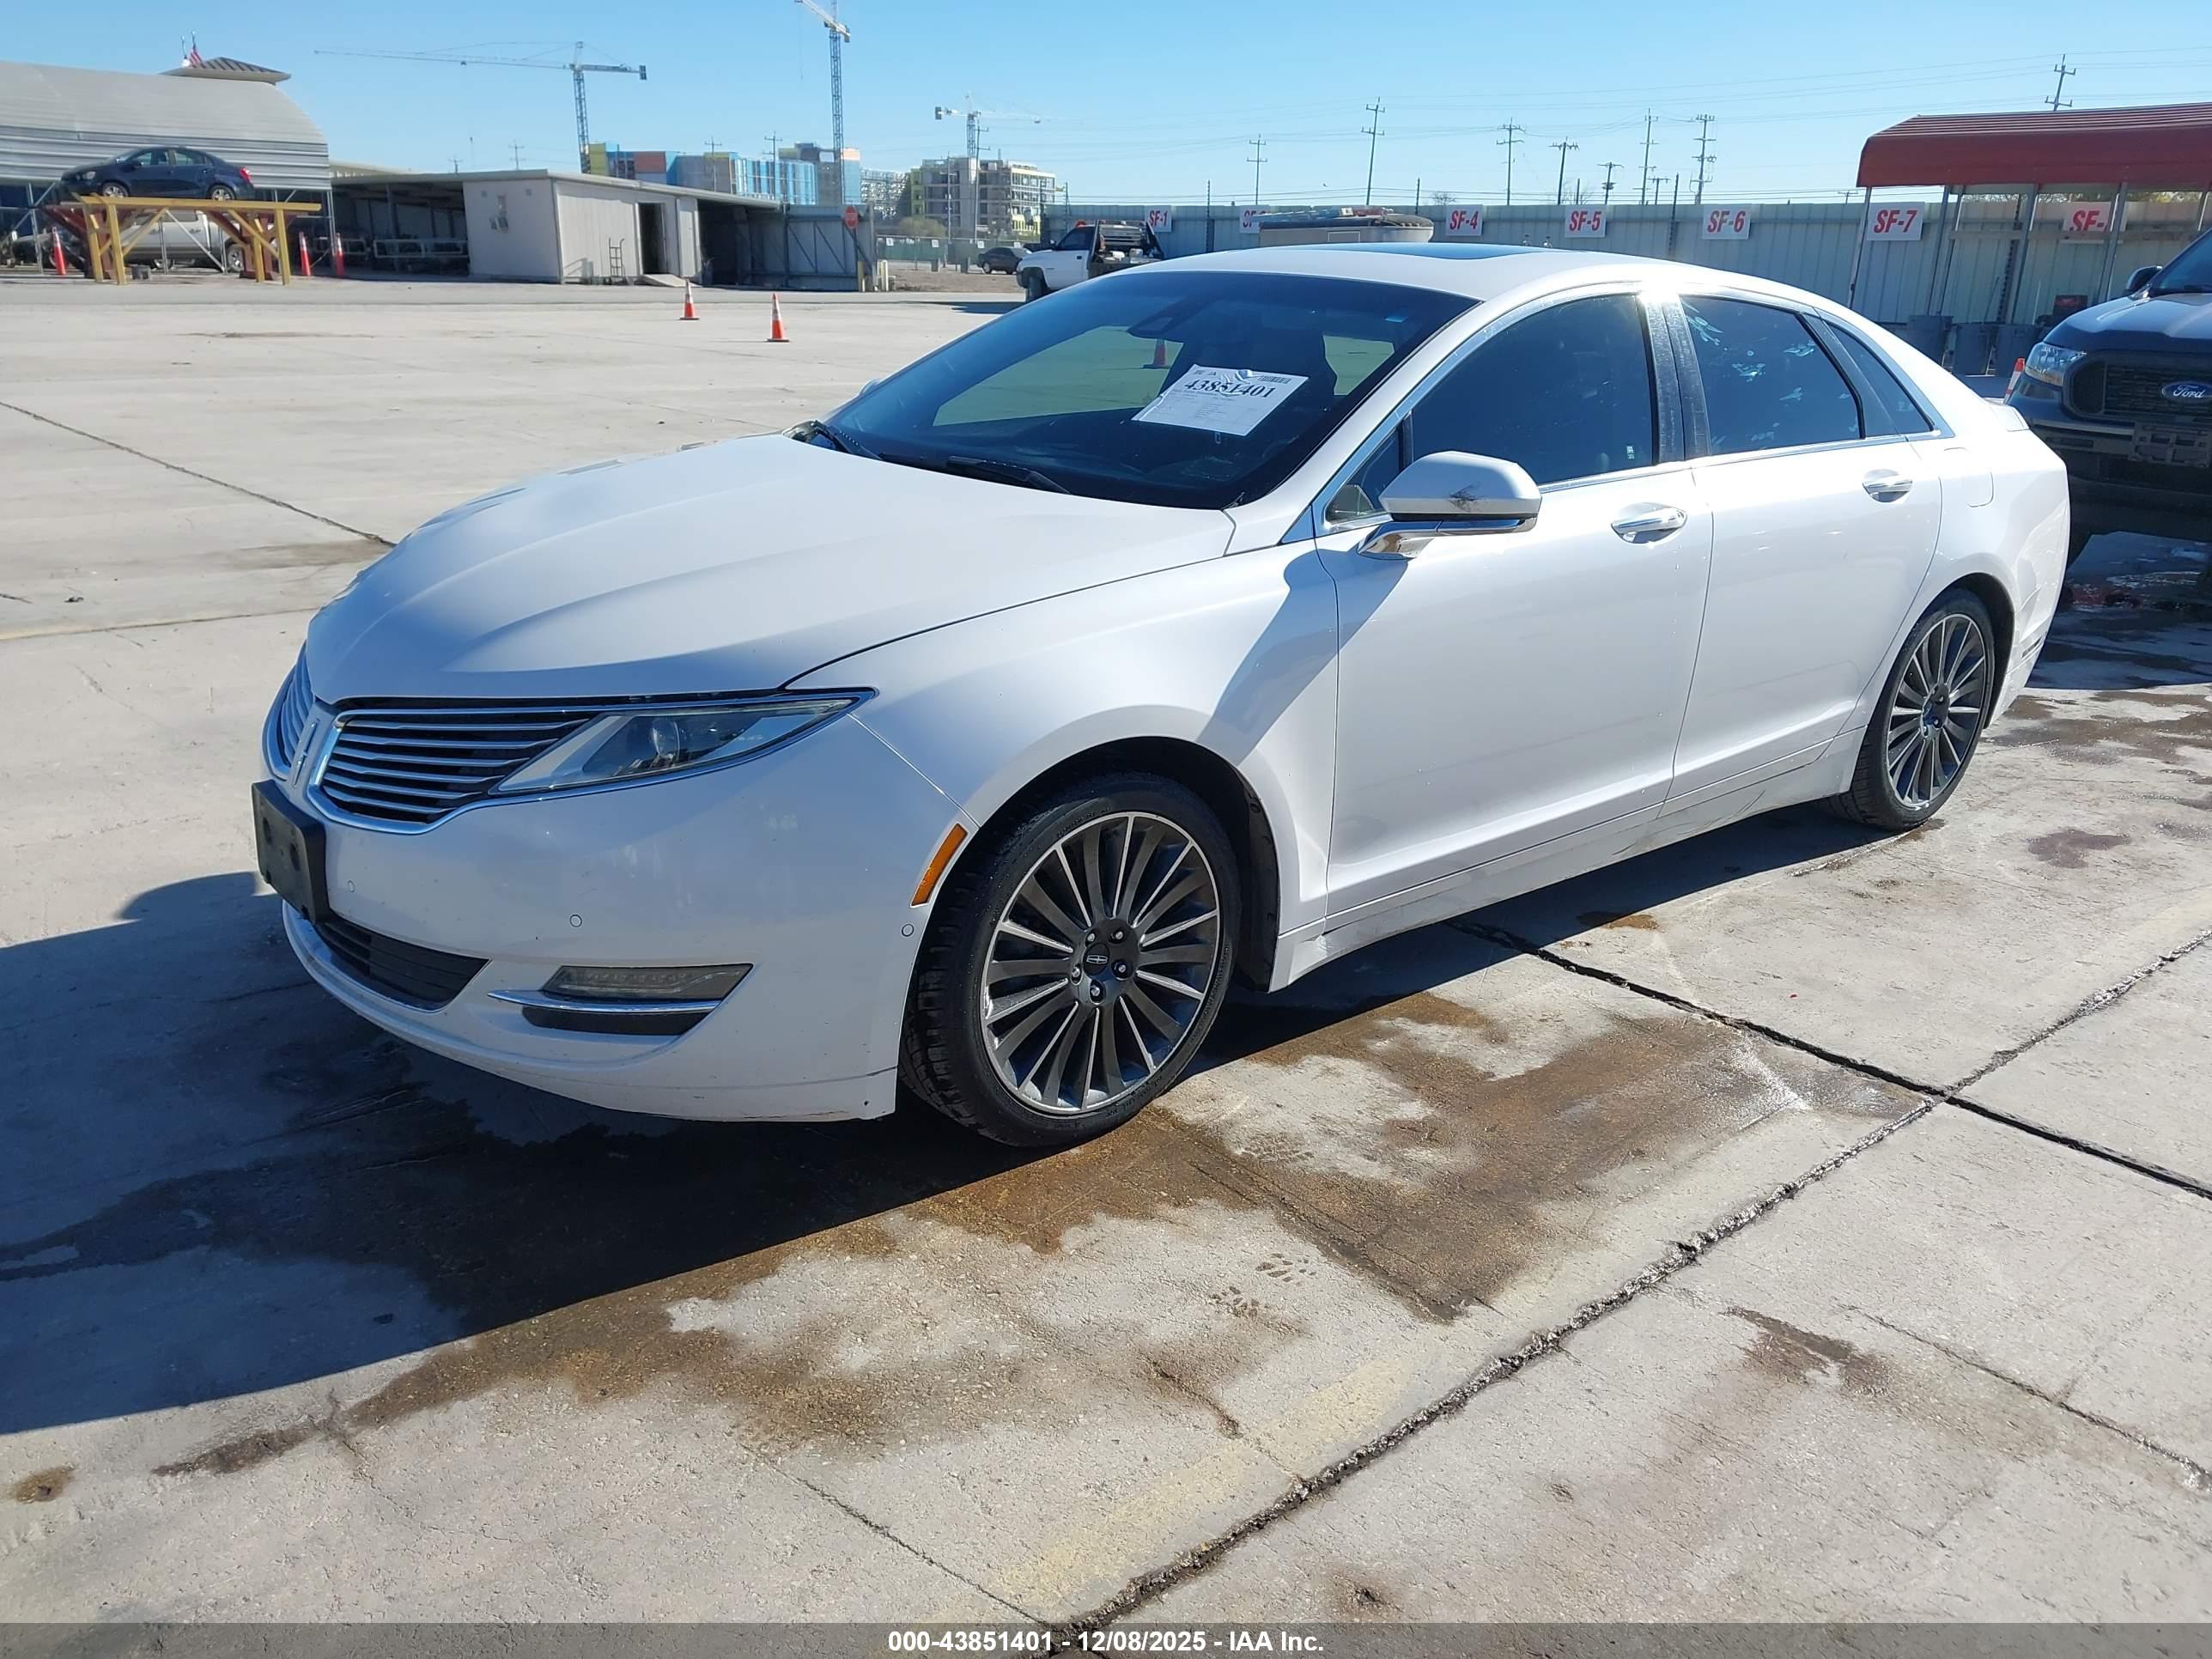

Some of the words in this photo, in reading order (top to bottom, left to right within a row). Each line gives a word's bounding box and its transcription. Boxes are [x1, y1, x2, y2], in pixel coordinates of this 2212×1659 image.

[1149, 210, 1169, 227] SF-1
[1449, 210, 1480, 230] SF-4
[1569, 210, 1602, 231] SF-5
[1707, 210, 1747, 234] SF-6
[1874, 209, 1917, 234] SF-7
[2069, 210, 2111, 233] SF-
[2172, 384, 2206, 398] Ford
